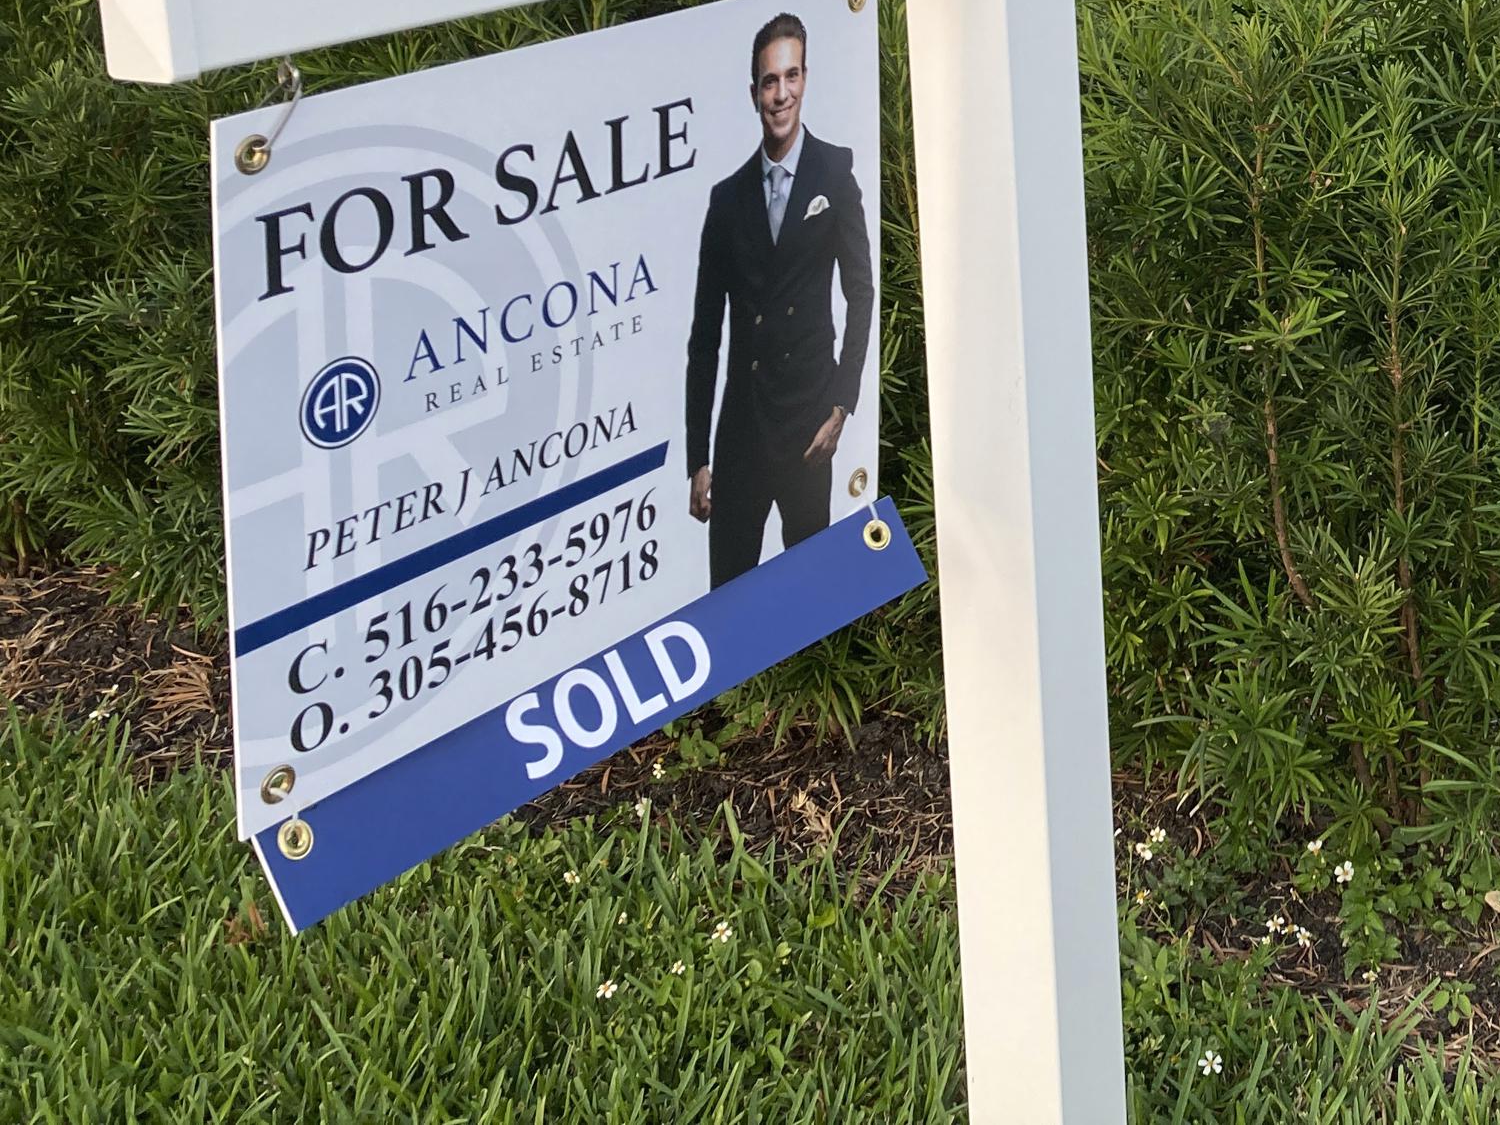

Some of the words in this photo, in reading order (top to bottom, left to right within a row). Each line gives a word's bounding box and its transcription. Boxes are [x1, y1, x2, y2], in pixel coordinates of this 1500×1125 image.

[255, 168, 469, 302] FOR
[495, 97, 697, 225] SALE
[403, 254, 658, 382] ANCONA
[424, 367, 509, 412] REAL
[530, 314, 644, 373] ESTATE
[304, 480, 444, 572] PETER
[441, 470, 471, 522] J
[480, 402, 638, 496] ANCONA
[288, 640, 345, 694] C.
[364, 488, 658, 663] 516-233-5976
[291, 702, 349, 752] O.
[369, 540, 660, 719] 305-456-8718
[504, 620, 712, 780] SOLD
